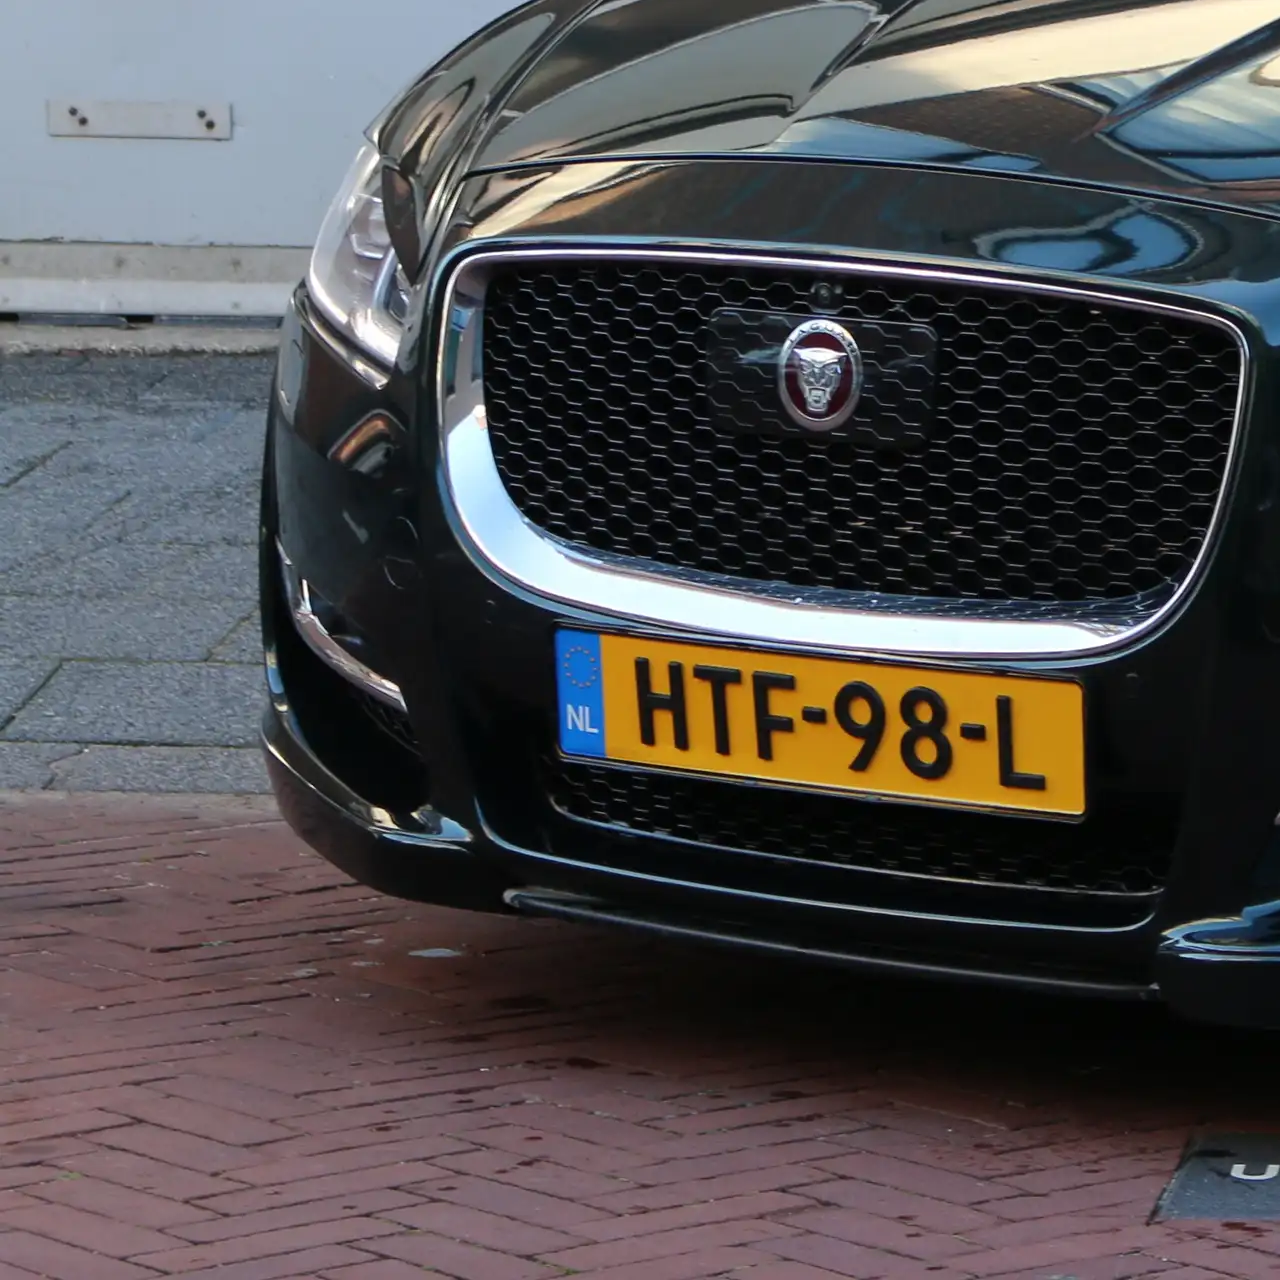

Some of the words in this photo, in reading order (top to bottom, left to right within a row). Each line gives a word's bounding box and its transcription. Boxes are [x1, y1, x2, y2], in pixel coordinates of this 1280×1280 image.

[785, 322, 858, 356] JAGUAR
[566, 703, 599, 734] NL
[634, 656, 1047, 792] HTF-98-L
